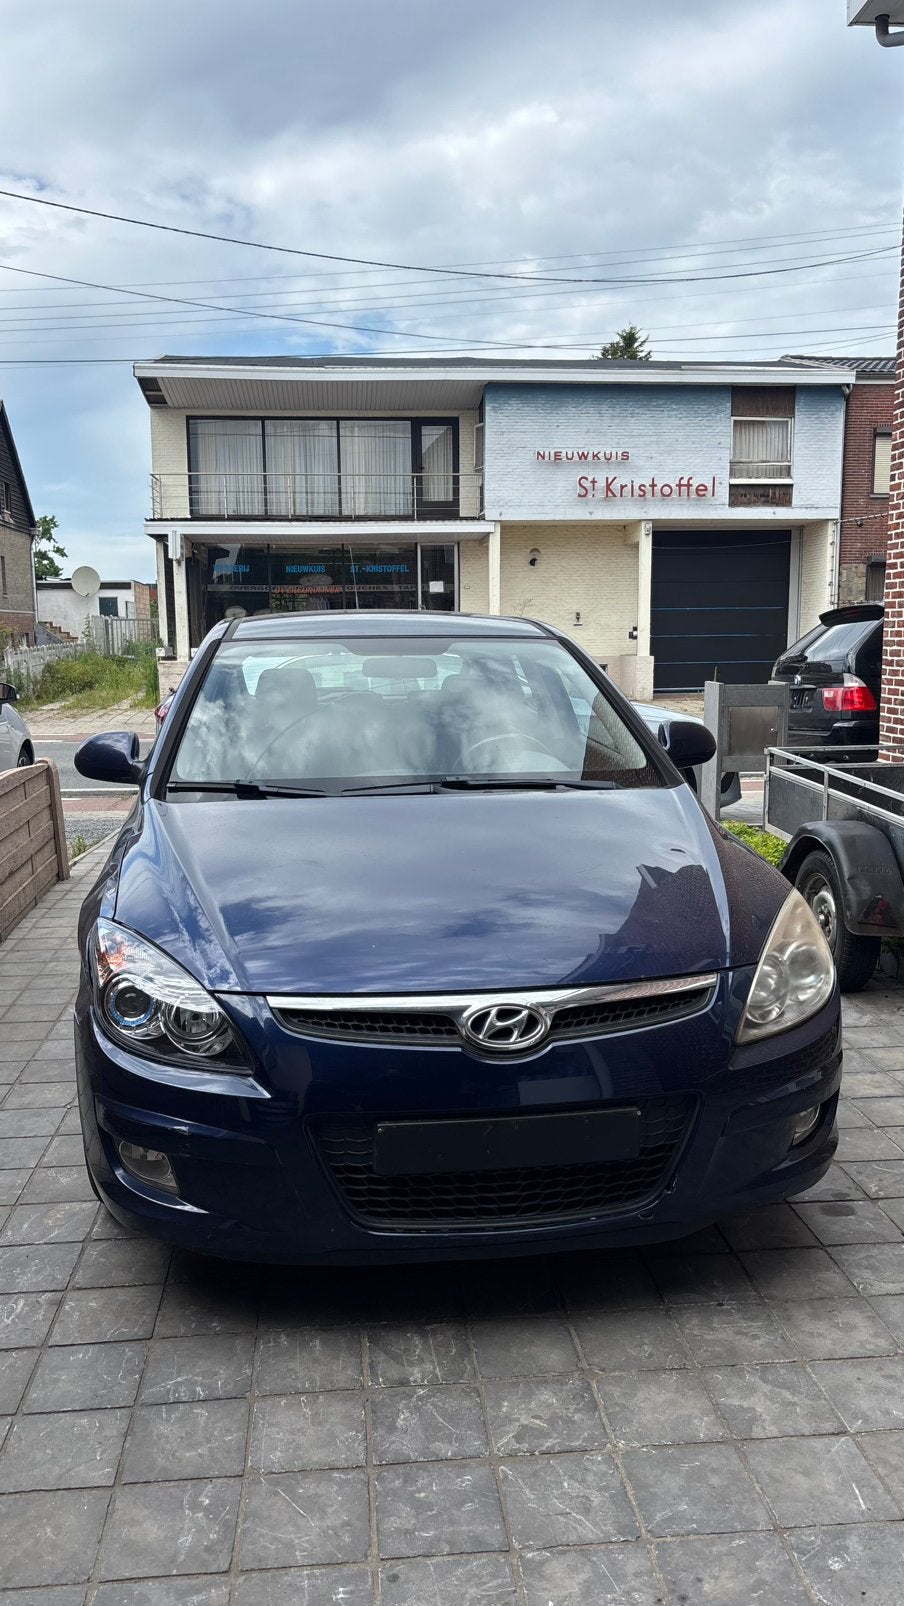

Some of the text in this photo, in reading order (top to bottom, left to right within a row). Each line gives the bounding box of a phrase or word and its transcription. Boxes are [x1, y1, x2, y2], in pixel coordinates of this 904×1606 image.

[537, 451, 630, 460] NIEUWKUIS
[605, 476, 716, 498] Kristoffel
[285, 564, 326, 573] NIEUWKUIS
